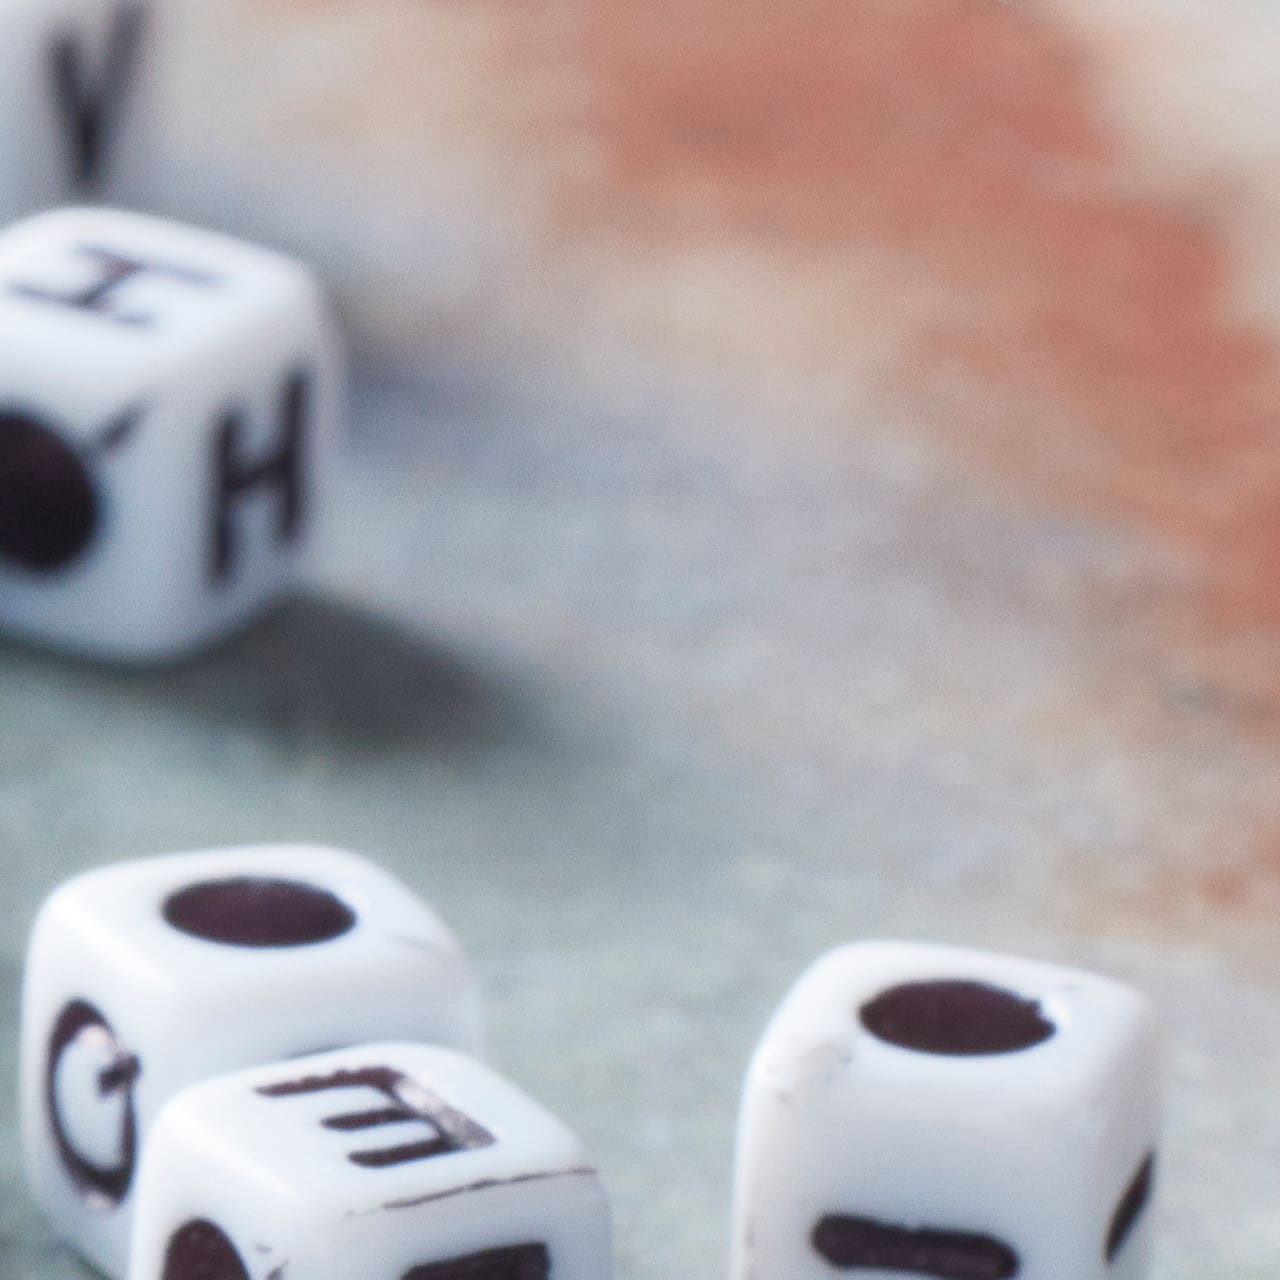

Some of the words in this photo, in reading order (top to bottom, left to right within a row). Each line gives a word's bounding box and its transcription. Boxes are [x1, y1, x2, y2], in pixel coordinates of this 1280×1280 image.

[2, 245, 224, 330] H
[210, 366, 312, 593] H
[46, 997, 140, 1210] G
[251, 1065, 498, 1168] E
